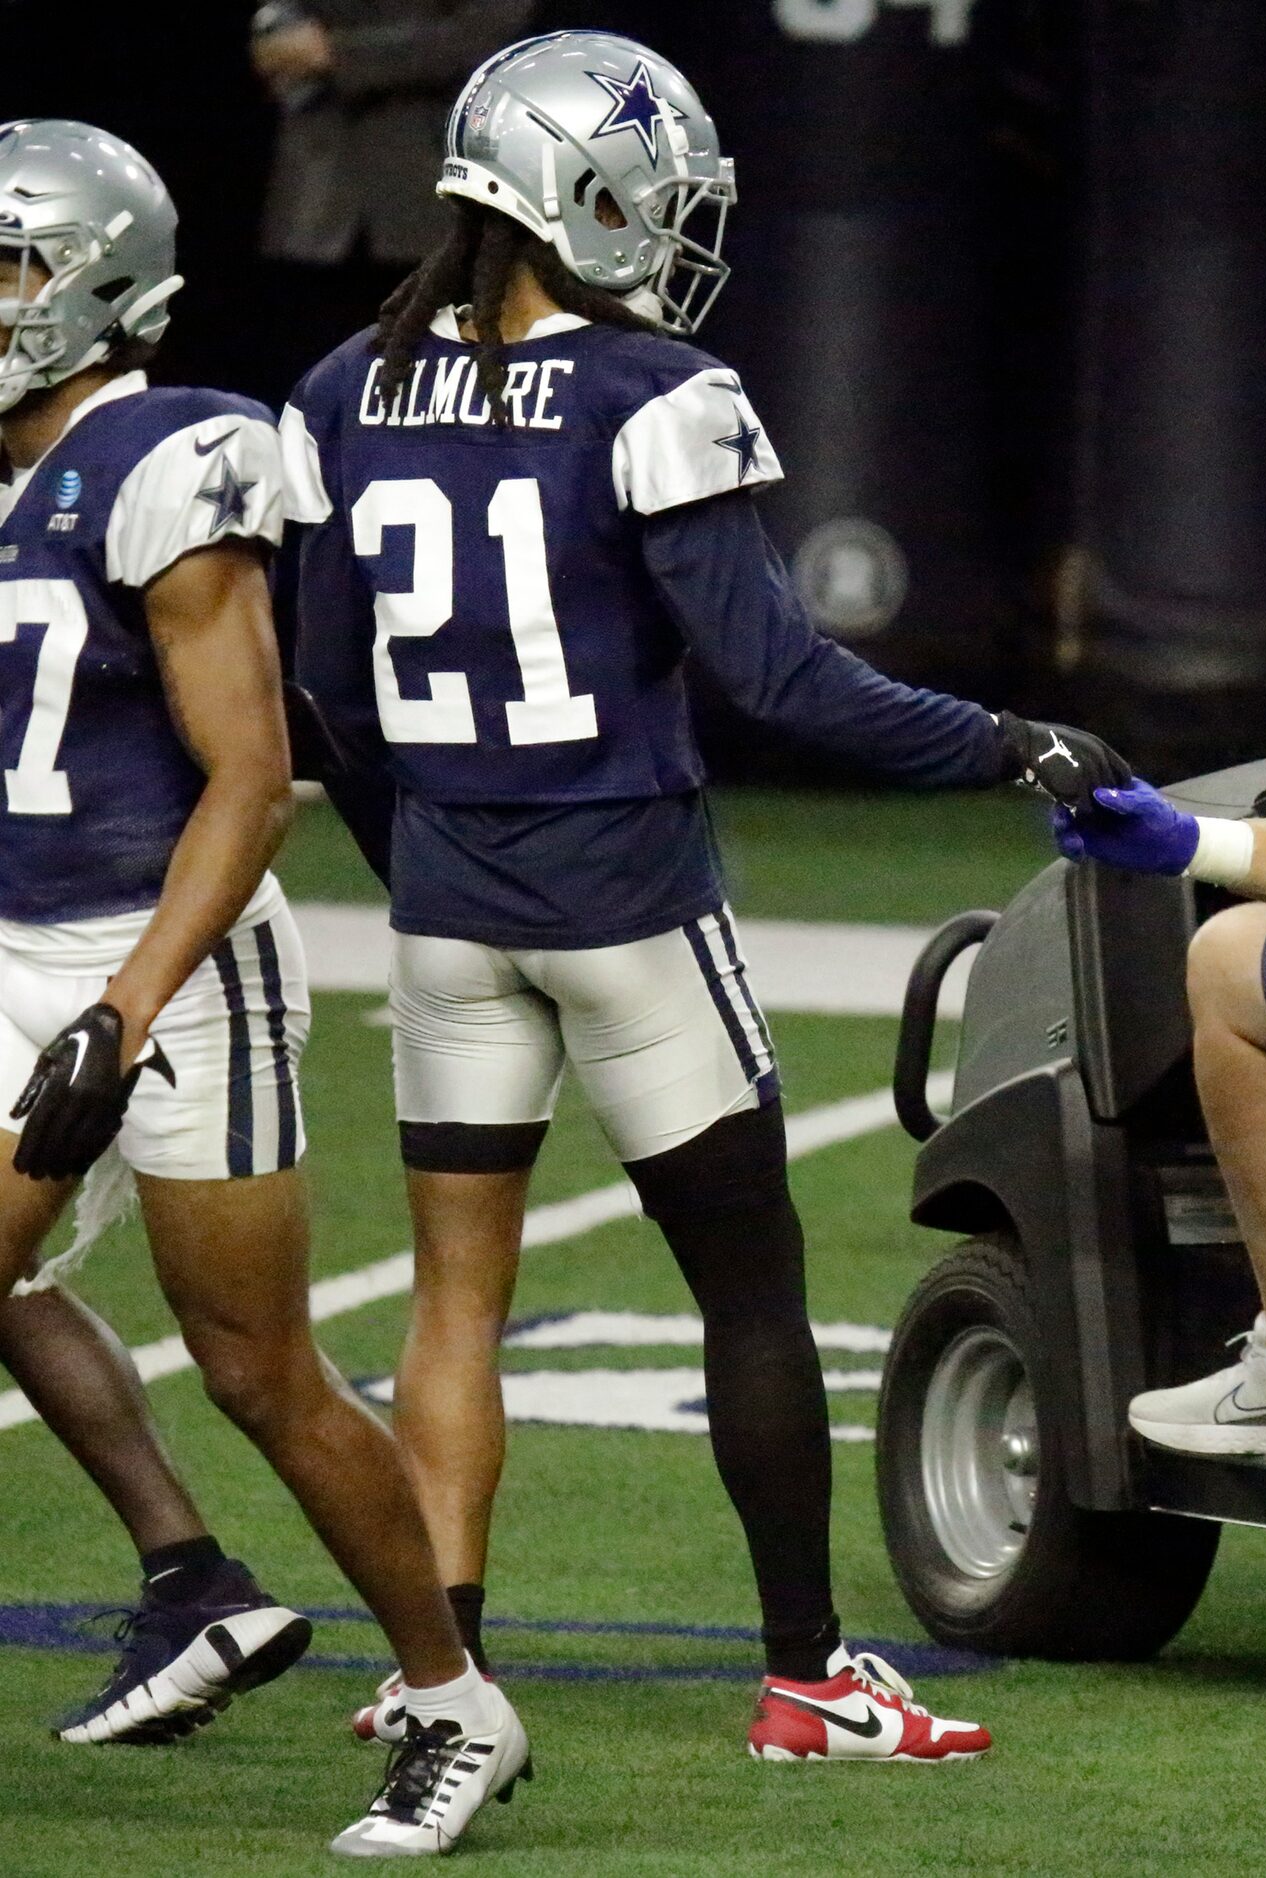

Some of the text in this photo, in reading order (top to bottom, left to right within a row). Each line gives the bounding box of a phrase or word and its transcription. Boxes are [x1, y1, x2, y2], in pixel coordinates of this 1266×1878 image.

[46, 513, 79, 532] AT&T
[351, 478, 598, 746] 21
[0, 578, 89, 815] 7
